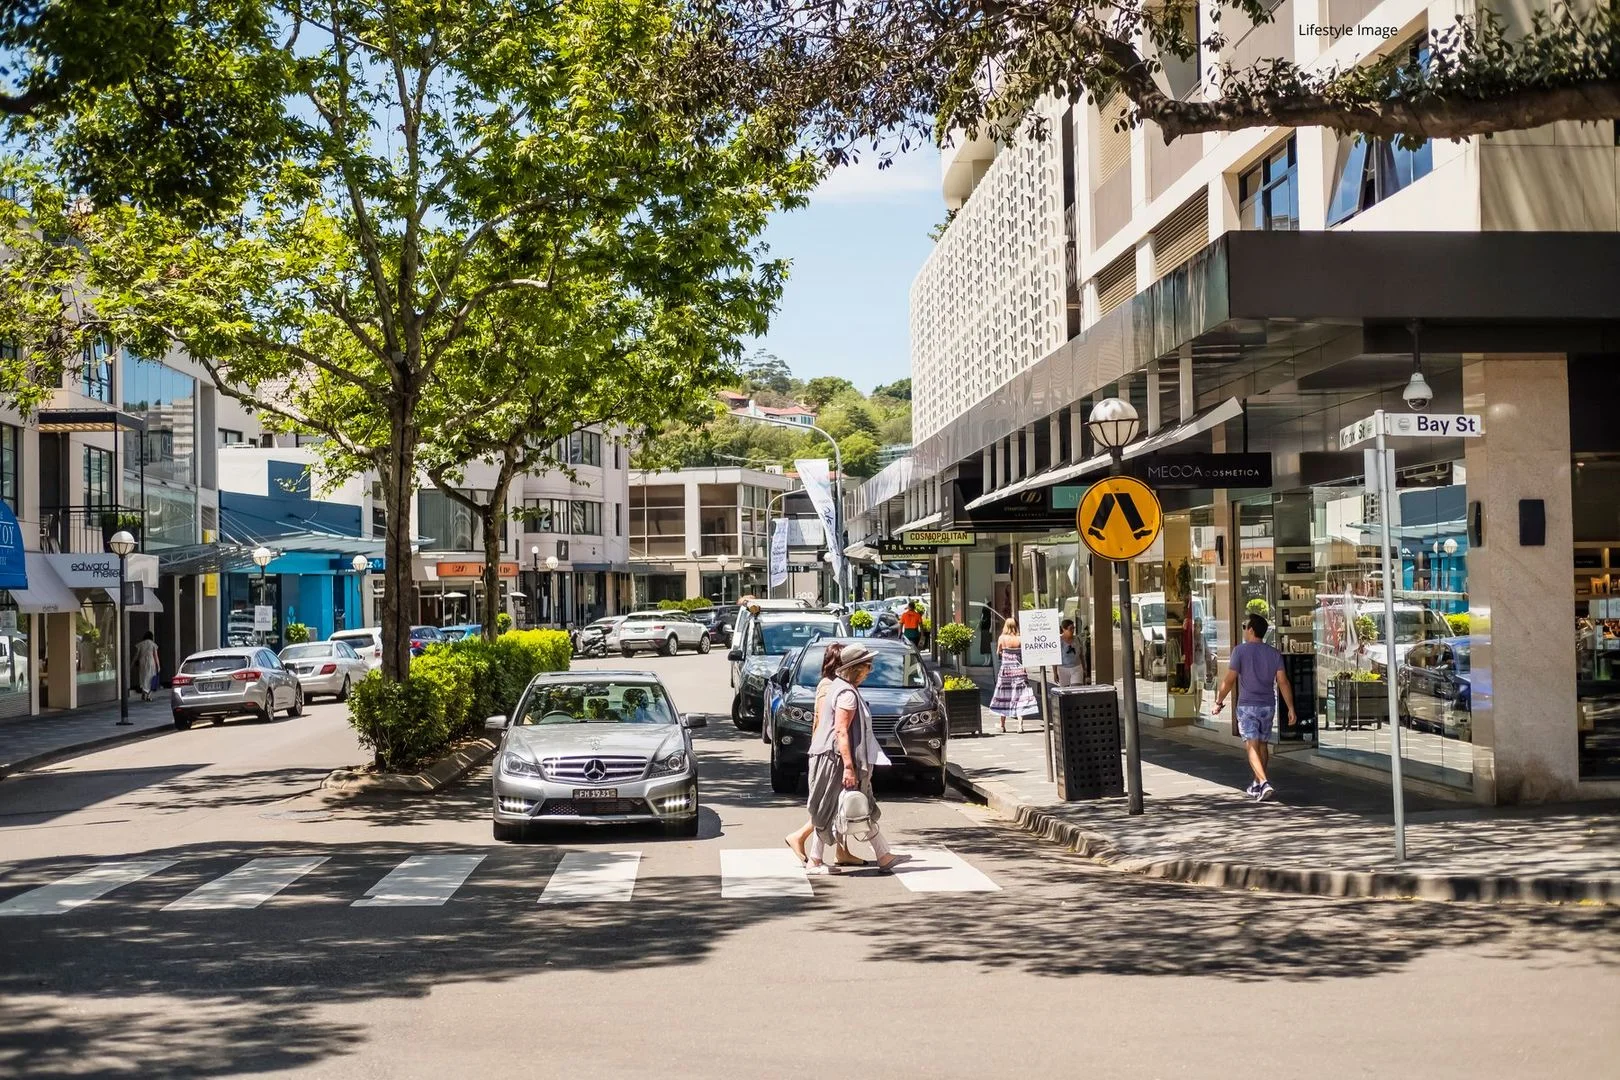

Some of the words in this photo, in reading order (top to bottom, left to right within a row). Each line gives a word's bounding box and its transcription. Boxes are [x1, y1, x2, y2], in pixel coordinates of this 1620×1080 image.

[1417, 415, 1450, 435] Bay
[1456, 416, 1476, 432] St
[1358, 423, 1366, 440] St
[1148, 465, 1203, 478] MECCA
[1205, 469, 1260, 477] COSMETICA
[0, 524, 14, 545] OY
[910, 532, 968, 541] COSMOPOLITAN
[71, 561, 110, 572] edward
[92, 568, 120, 578] melle
[1034, 635, 1047, 643] NO
[1024, 641, 1058, 650] PARKING
